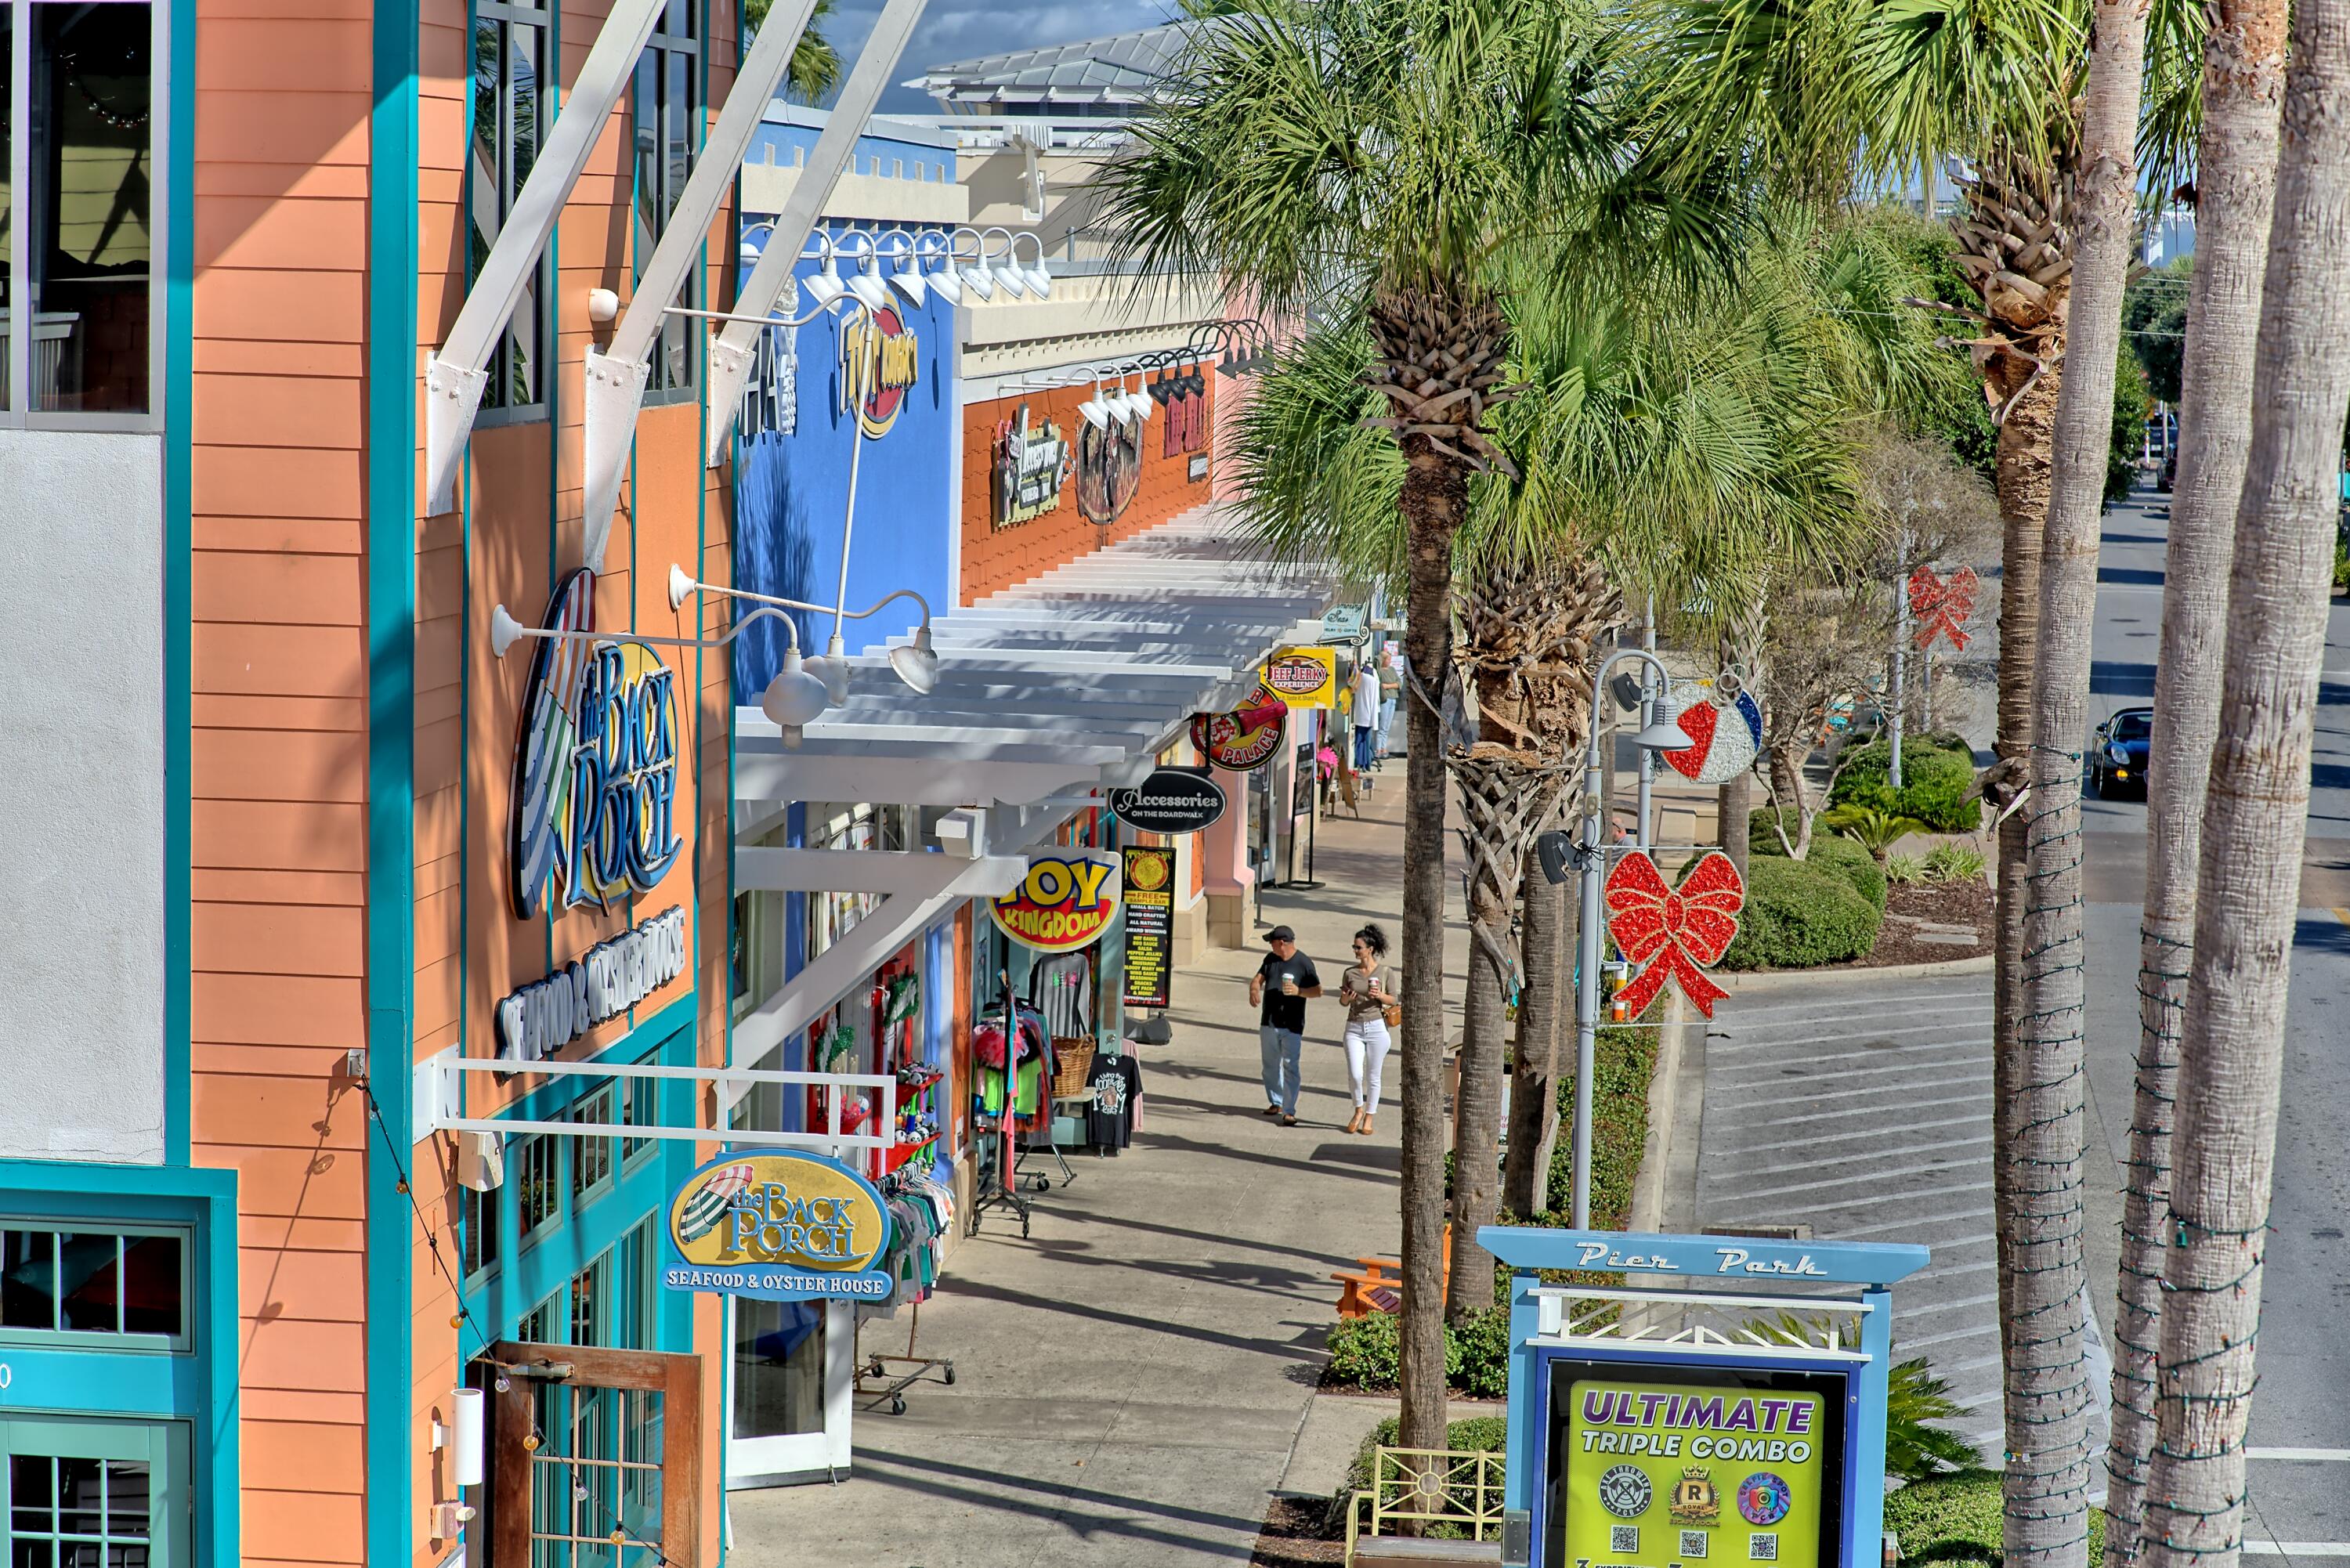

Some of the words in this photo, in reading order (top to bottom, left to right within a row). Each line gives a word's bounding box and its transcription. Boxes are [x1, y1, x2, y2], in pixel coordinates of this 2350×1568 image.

[1292, 666, 1327, 681] JERKY
[595, 645, 674, 782] BACK
[1221, 728, 1278, 764] PALACE
[1116, 787, 1218, 812] Accessories
[566, 746, 684, 905] PORCH
[1003, 909, 1101, 939] KINGDOM
[733, 1185, 763, 1209] the
[761, 1181, 855, 1227] BACK
[727, 1207, 871, 1262] PORCH
[1574, 1241, 1679, 1270] Pier
[1715, 1248, 1828, 1276] Park
[667, 1270, 744, 1289] SEAFOOD
[747, 1273, 760, 1289] &
[761, 1274, 828, 1292] OYSTER
[829, 1277, 884, 1295] HOUSE
[1581, 1390, 1816, 1435] ULTIMATE
[1581, 1429, 1683, 1458] TRIPLE
[1690, 1435, 1812, 1463] COMBO
[1600, 1473, 1611, 1490] AXE
[1612, 1465, 1651, 1494] THROWING
[1687, 1484, 1701, 1501] R
[1739, 1474, 1767, 1496] SELFIE
[1772, 1476, 1790, 1498] SPOT
[1617, 1507, 1635, 1516] PCB
[1752, 1512, 1775, 1521] PCB
